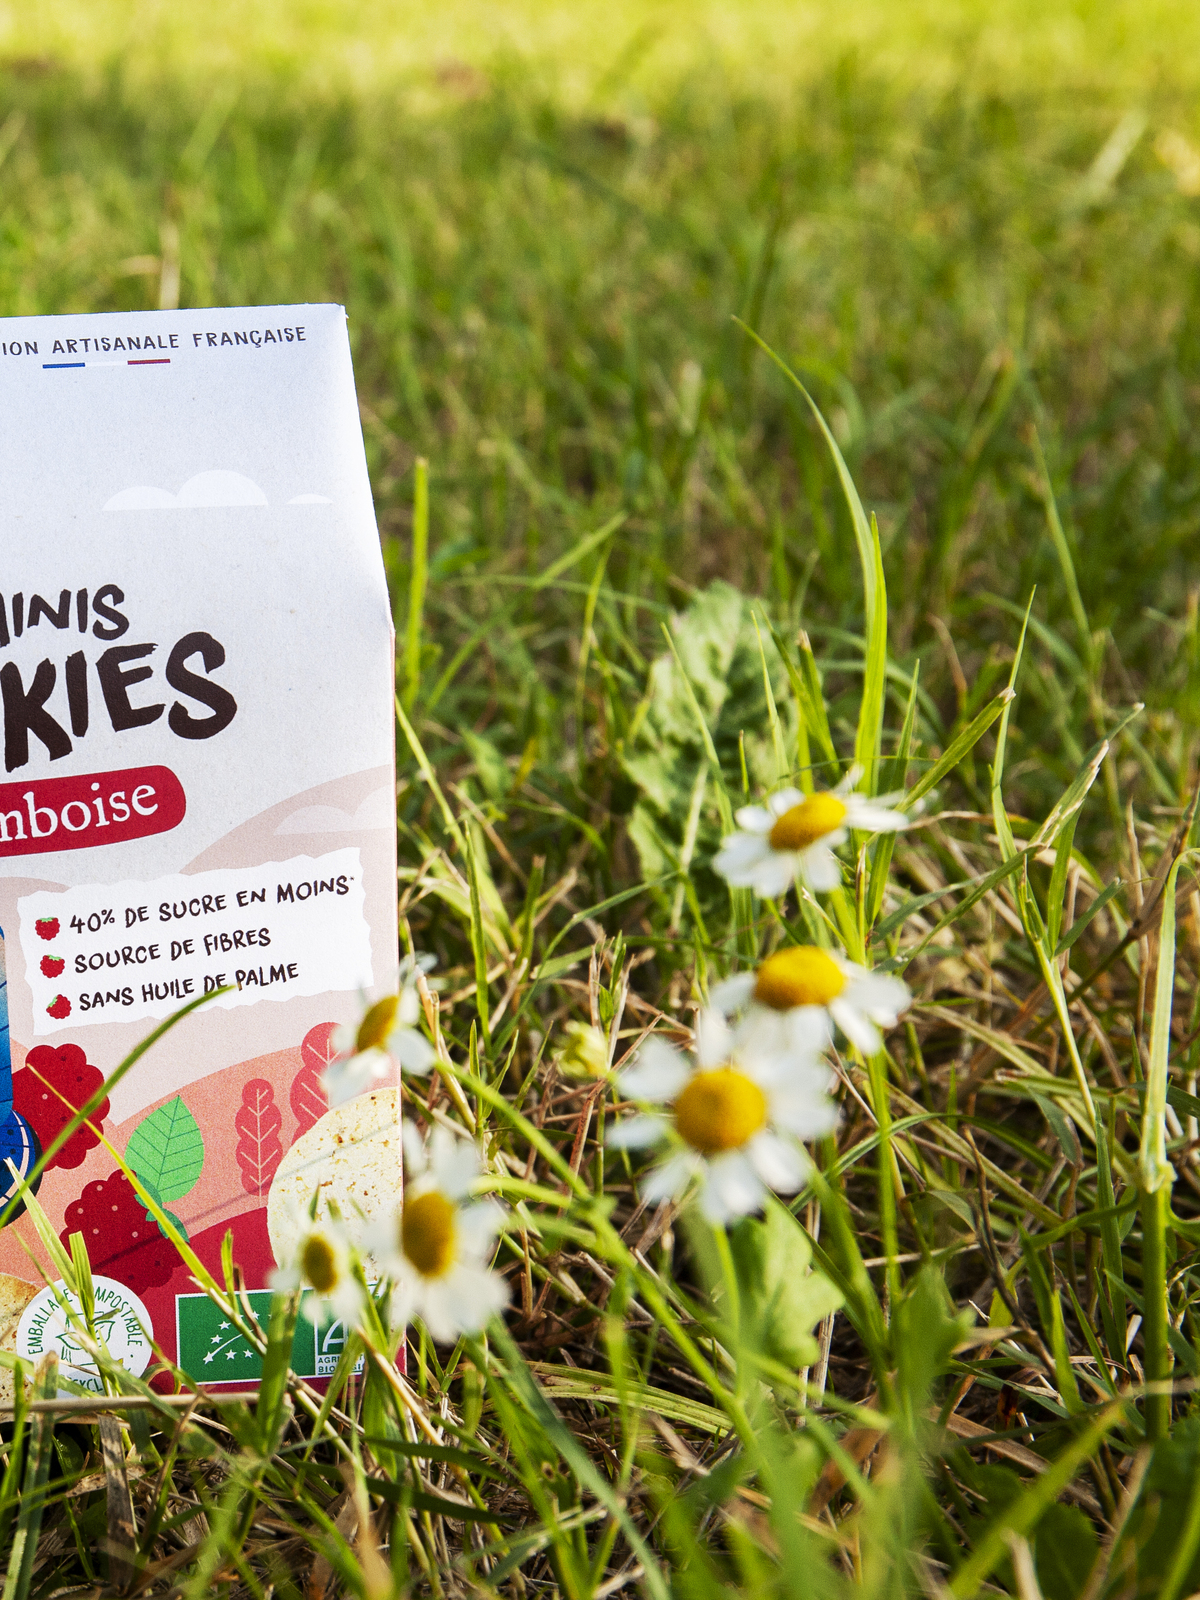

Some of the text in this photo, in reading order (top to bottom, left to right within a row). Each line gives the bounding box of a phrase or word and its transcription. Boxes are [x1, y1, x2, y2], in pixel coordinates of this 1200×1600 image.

[51, 334, 179, 355] ARTISANALE
[192, 326, 307, 350] FRANÇAISE
[69, 908, 115, 934] 40%
[125, 905, 150, 929] DE
[159, 894, 227, 922] SUCRE
[236, 887, 267, 907] EN
[74, 927, 272, 974] SOURCE DE FIBRES
[79, 962, 300, 1011] SANS HUILE DE PALME
[27, 1286, 143, 1355] EMBALLAE MPOSTABLE
